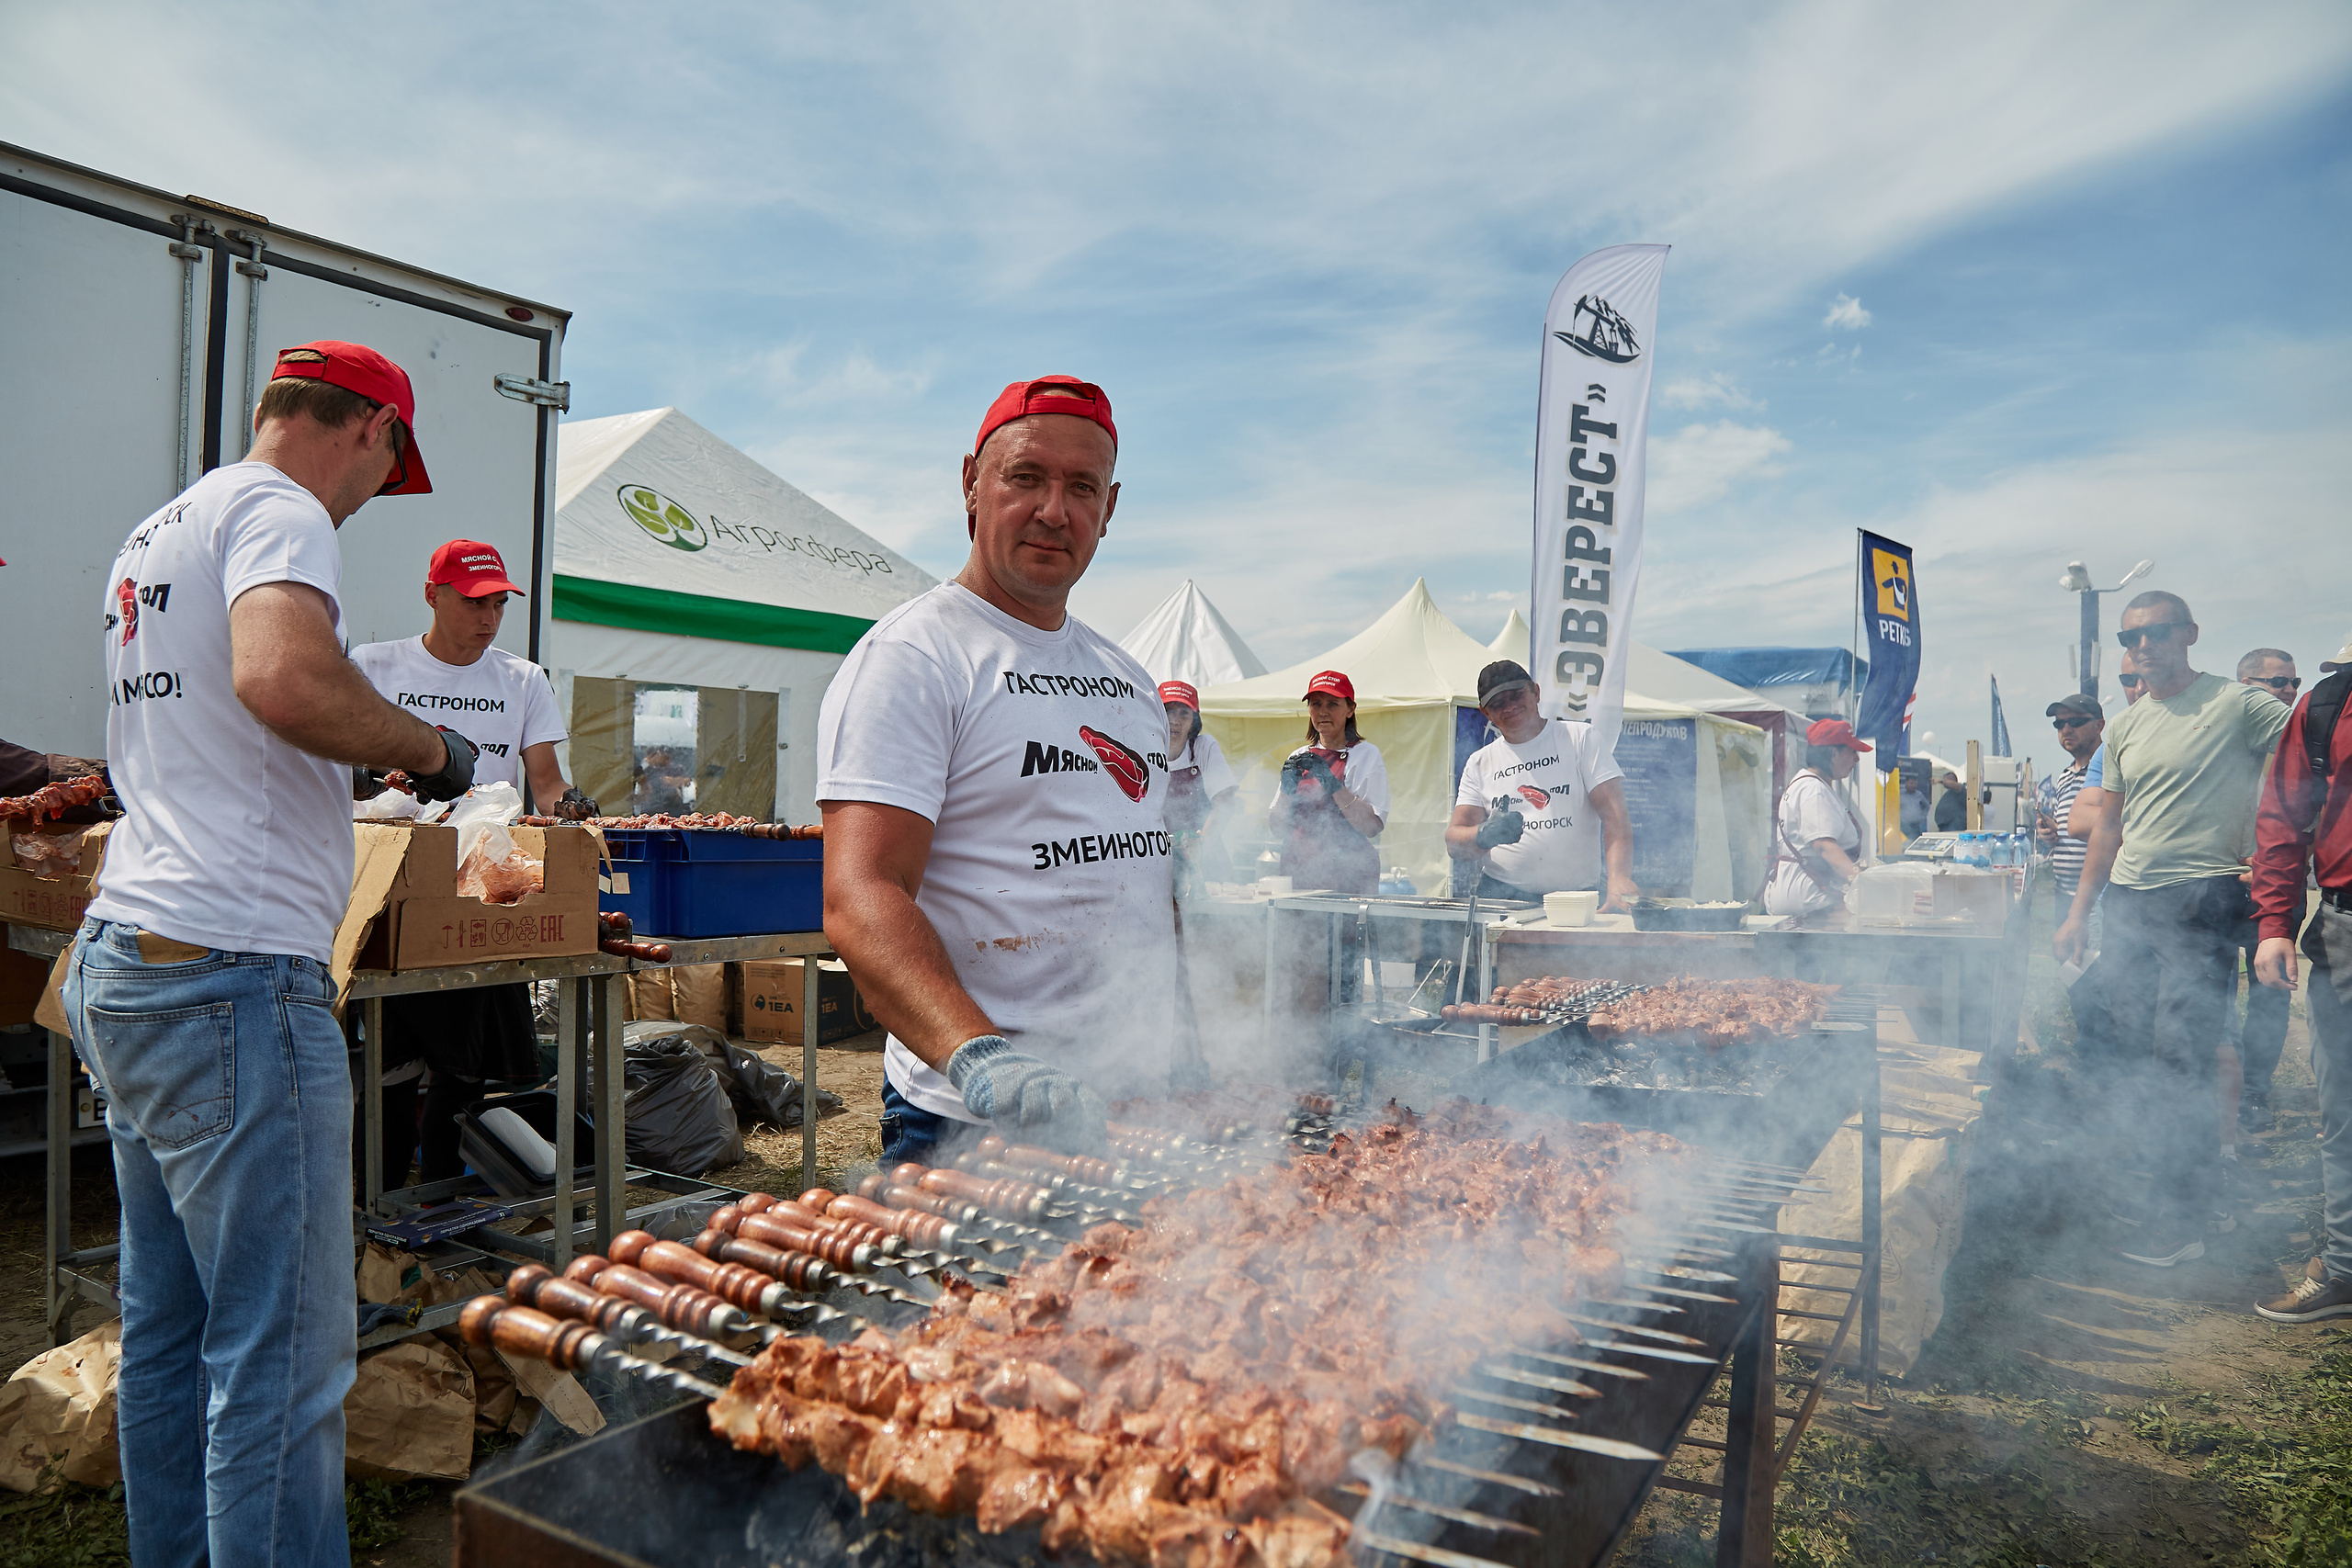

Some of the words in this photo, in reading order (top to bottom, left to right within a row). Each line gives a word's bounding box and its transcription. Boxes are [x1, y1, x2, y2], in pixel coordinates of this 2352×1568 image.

[461, 554, 492, 564] МЯСНОЙ
[710, 514, 893, 577] Агросфера
[1555, 383, 1618, 713] «ЭВЕРЕСТ»
[122, 671, 182, 705] МСО!
[1002, 671, 1136, 699] ГАСТРОНОМ
[398, 693, 505, 713] ГАСТРОНОМ
[1493, 754, 1560, 780] ГАСТРОНОМ
[1523, 816, 1573, 830] НОГОРСК
